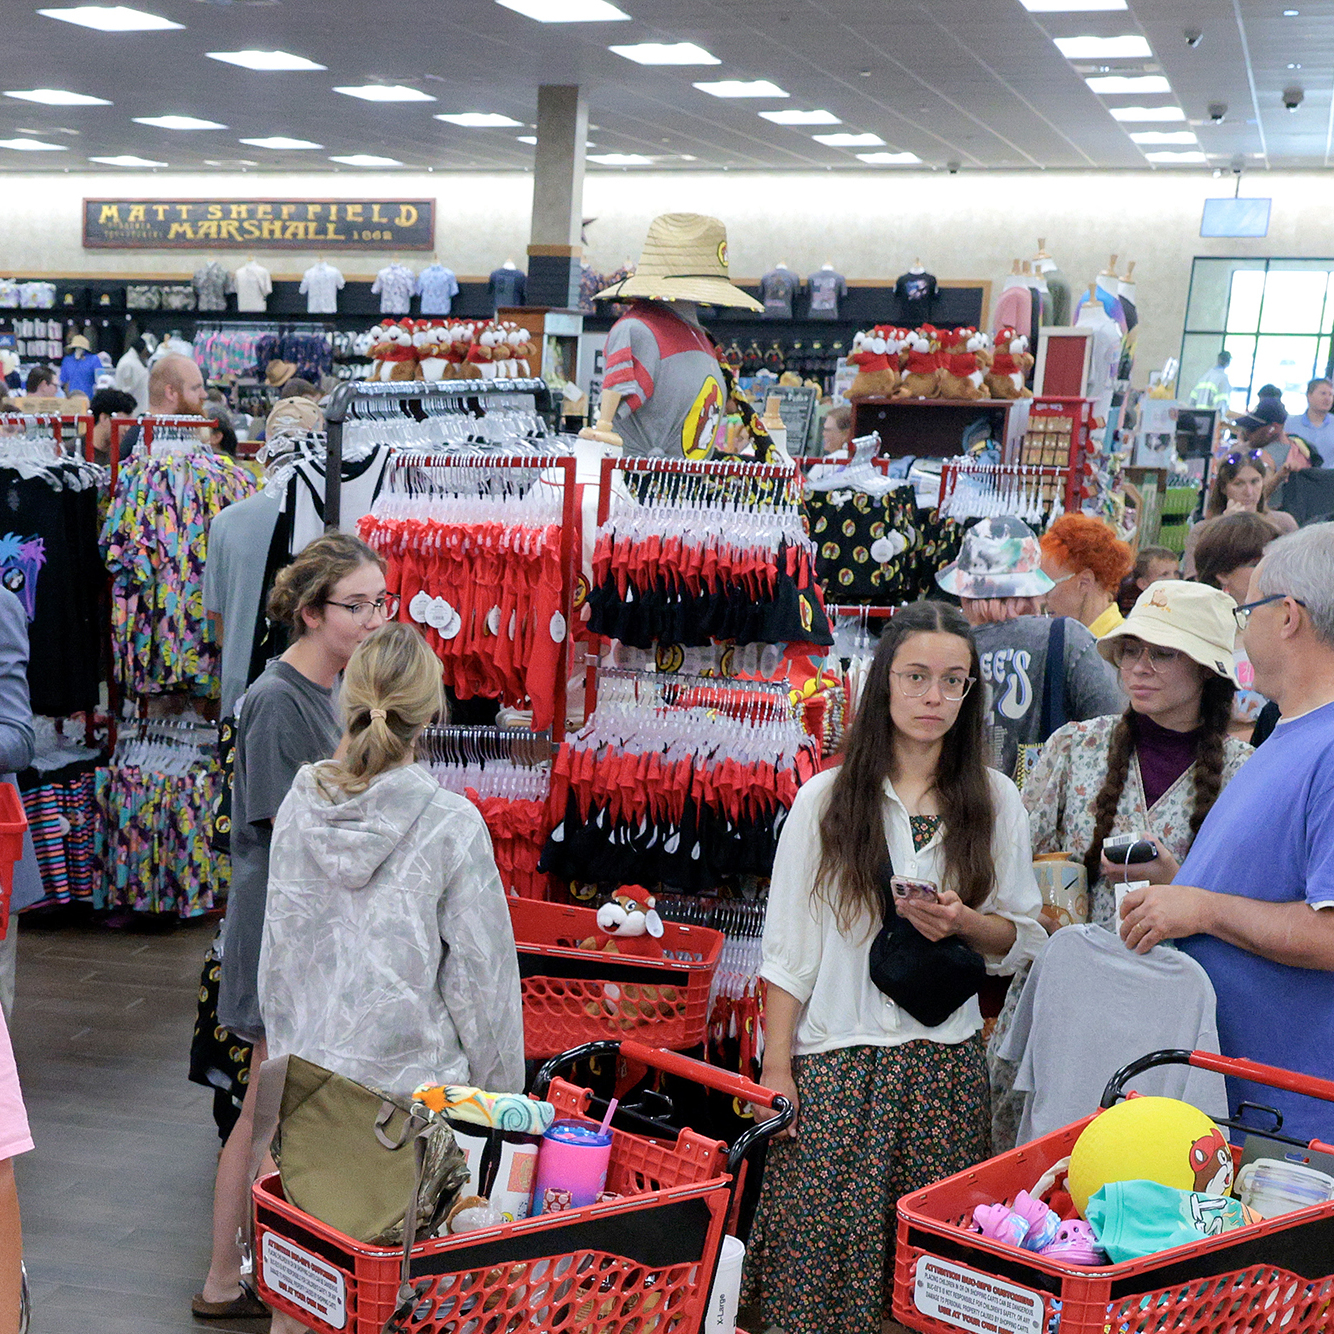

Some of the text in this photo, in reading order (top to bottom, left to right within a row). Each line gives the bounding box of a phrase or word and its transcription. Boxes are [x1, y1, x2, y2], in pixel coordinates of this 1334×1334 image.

[98, 204, 193, 224] MATT
[167, 219, 346, 241] MARSHALL
[939, 1277, 955, 1288] CHILDREN
[970, 1288, 986, 1300] SHOPPING
[988, 1294, 998, 1304] CARTS
[717, 1293, 726, 1326] X-Large
[938, 1305, 951, 1316] USE
[952, 1310, 961, 1320] AT
[962, 1314, 980, 1326] YOUR
[981, 1321, 997, 1332] OWN
